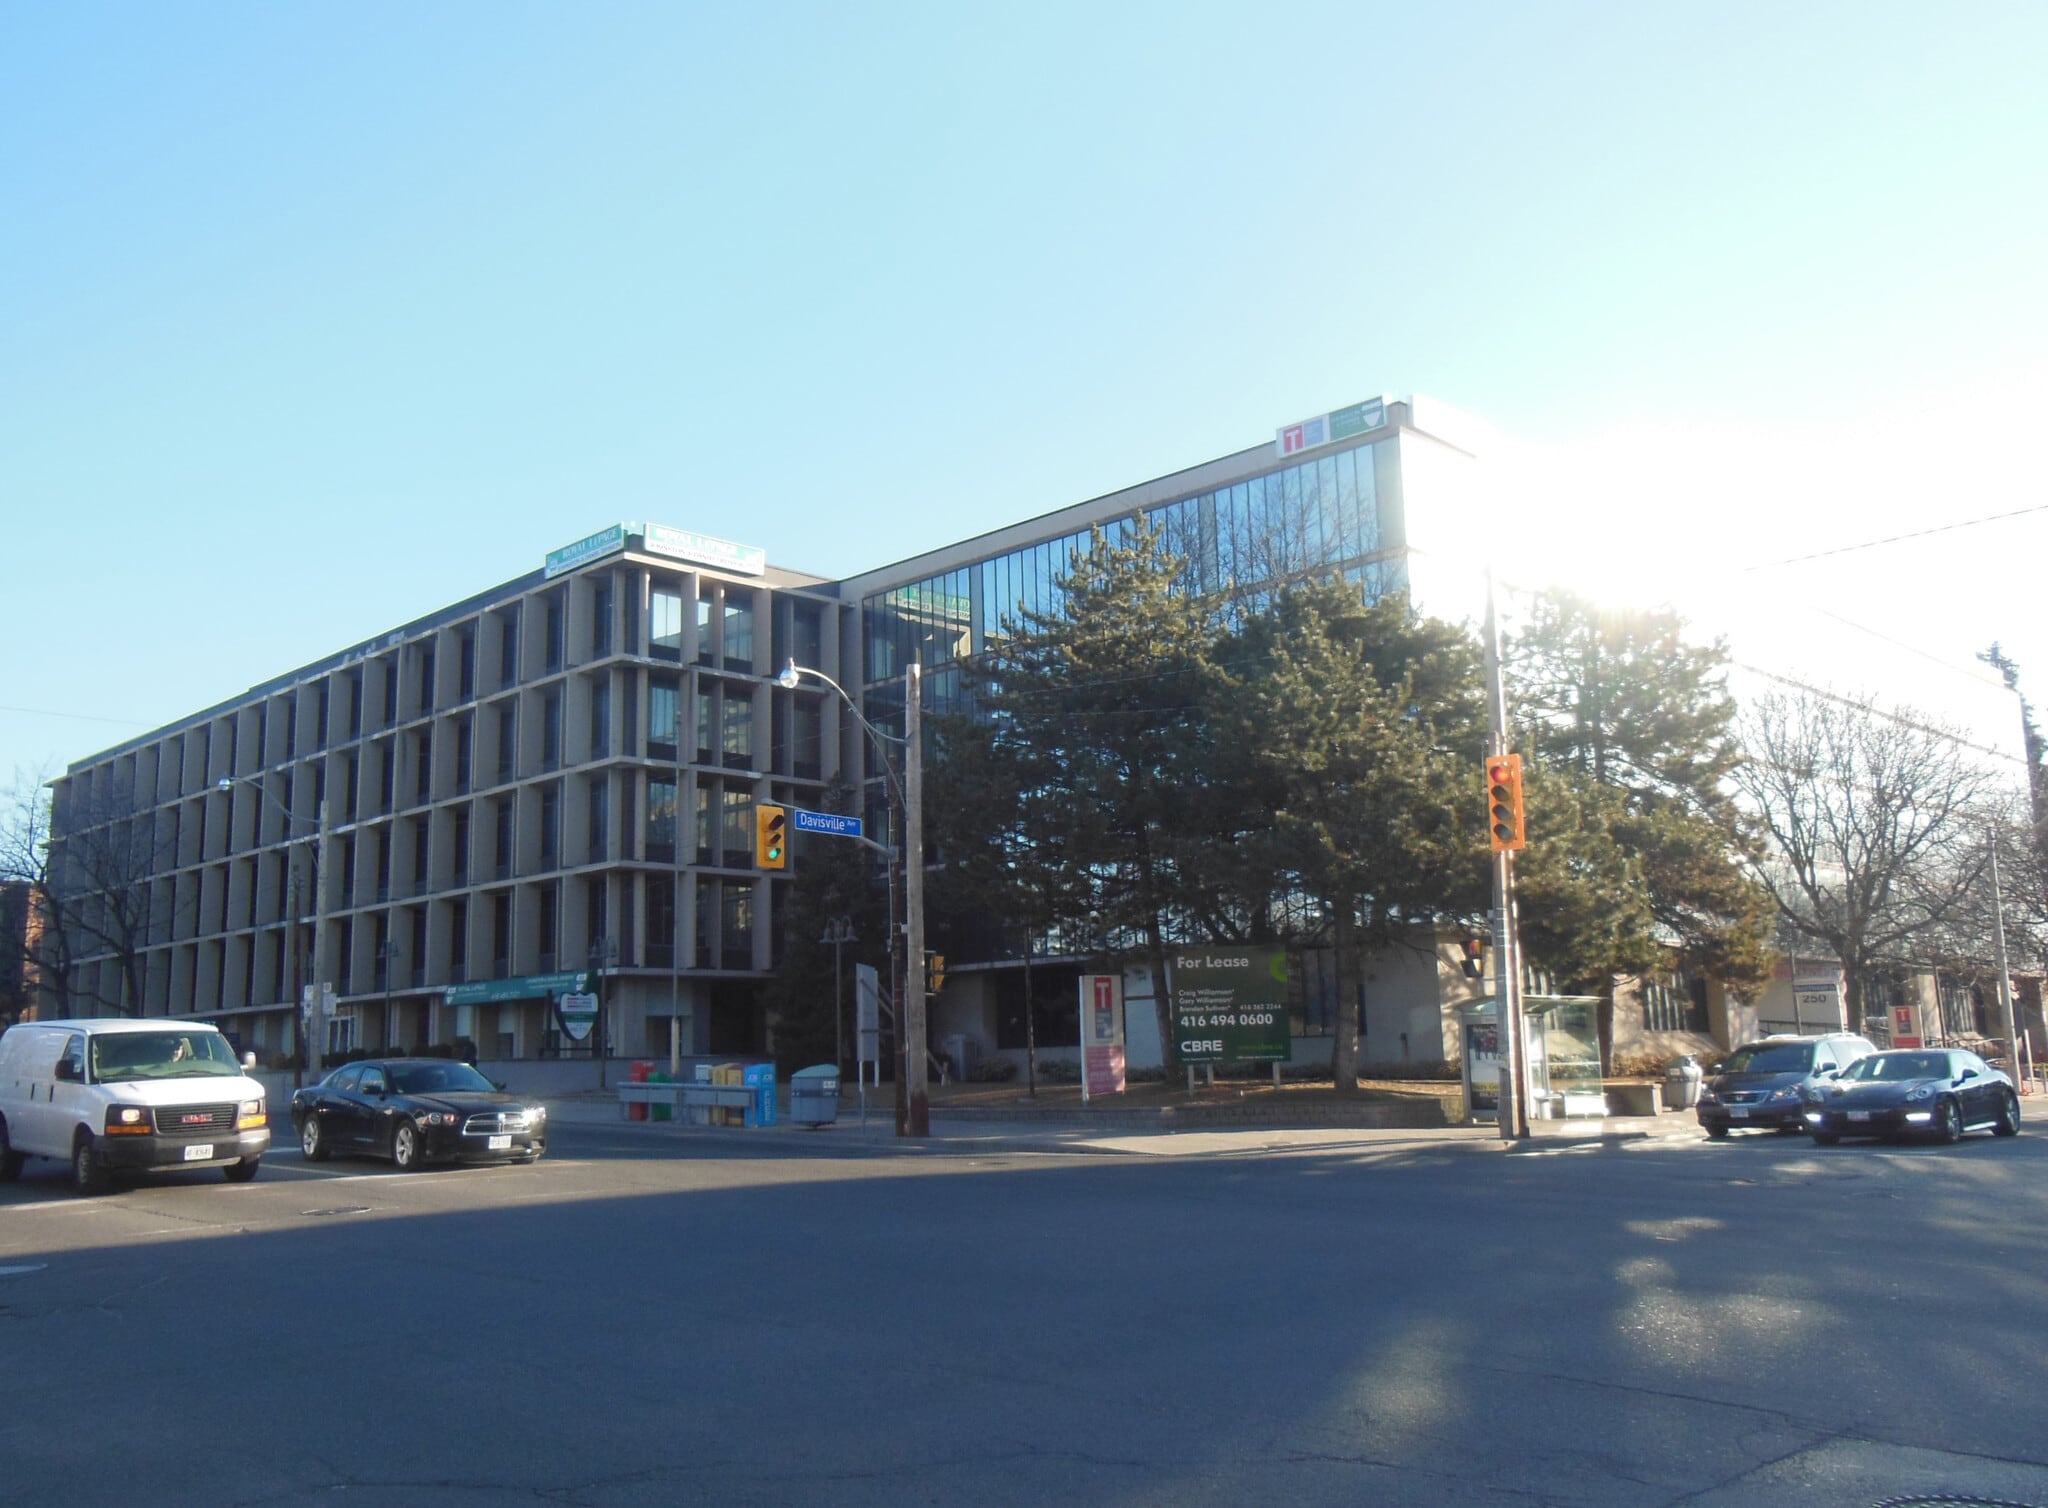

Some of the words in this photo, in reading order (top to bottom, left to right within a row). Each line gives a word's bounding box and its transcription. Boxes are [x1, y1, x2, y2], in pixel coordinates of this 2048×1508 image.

[800, 813, 845, 830] Davisville
[1177, 956, 1202, 969] For
[1205, 955, 1249, 968] Lease
[1178, 989, 1197, 997] Craig
[1803, 994, 1826, 1004] 250
[1178, 997, 1195, 1005] Gary
[1181, 1015, 1206, 1027] 416
[1210, 1014, 1236, 1026] 494
[1239, 1013, 1273, 1025] 0600
[1181, 1040, 1223, 1052] CBRE
